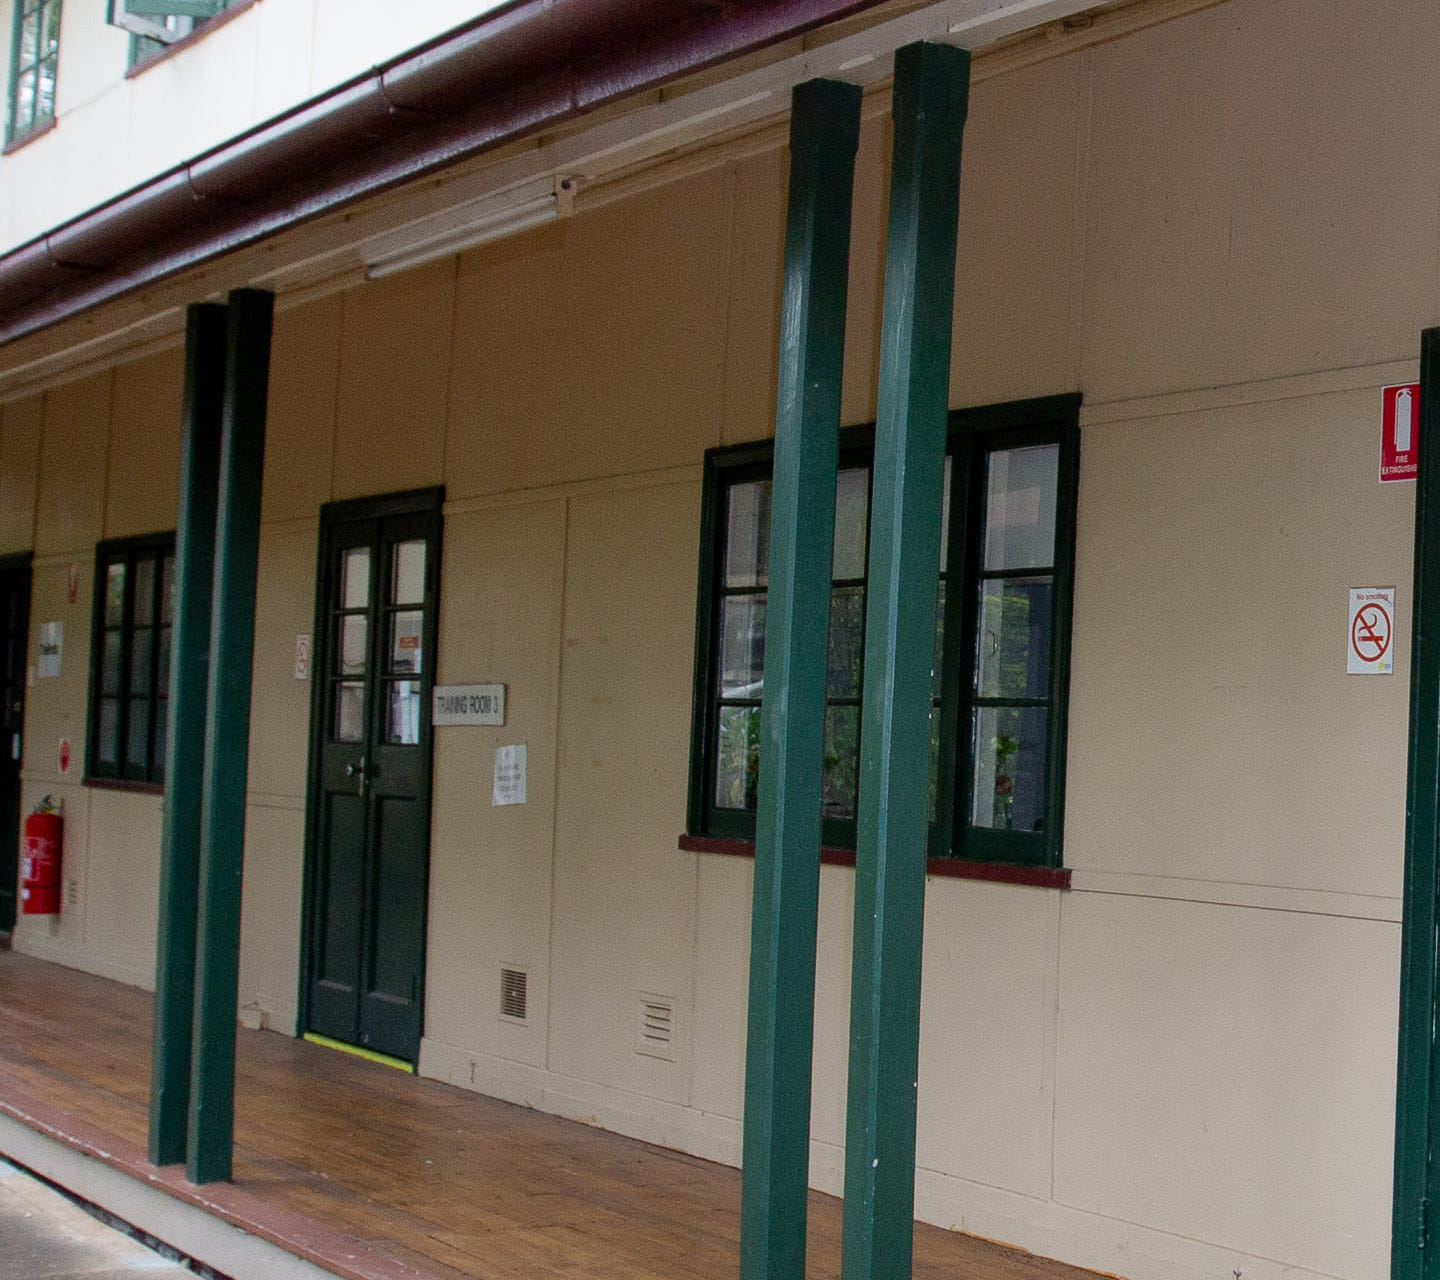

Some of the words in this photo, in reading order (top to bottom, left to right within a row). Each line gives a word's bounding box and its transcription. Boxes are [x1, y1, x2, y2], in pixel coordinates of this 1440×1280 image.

[1395, 454, 1408, 463] FIRE
[1382, 463, 1418, 475] EXTINGUISHE
[1356, 593, 1365, 601] No
[436, 695, 468, 714] TRAINING
[469, 695, 491, 714] ROOM
